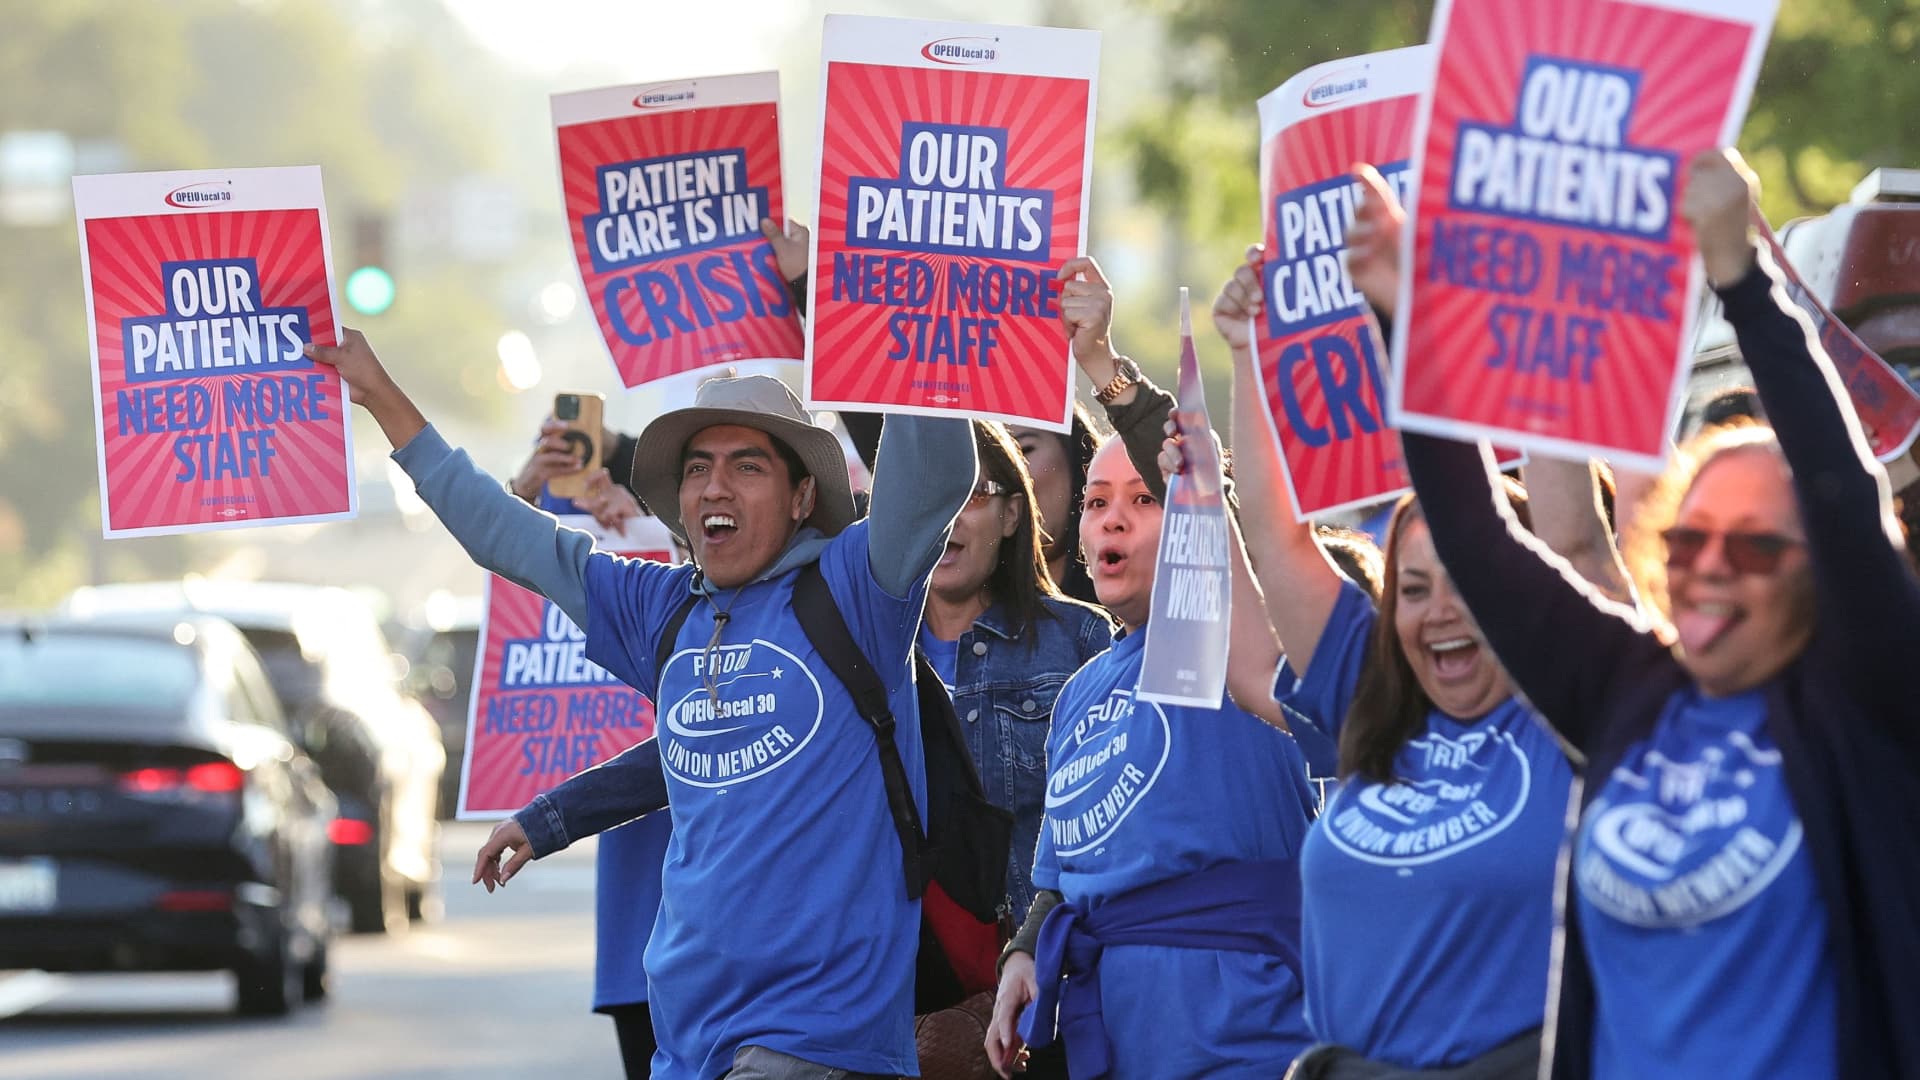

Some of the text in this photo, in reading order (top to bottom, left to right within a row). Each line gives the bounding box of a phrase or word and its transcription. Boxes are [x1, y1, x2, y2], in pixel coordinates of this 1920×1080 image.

[934, 44, 995, 60] OPEIU Local 30
[1520, 64, 1631, 147] OUR
[604, 154, 739, 214] PATIENT
[909, 130, 998, 191] OUR
[1455, 127, 1674, 233] PATIENTS
[176, 191, 231, 202] OPEIU Local 30
[856, 184, 1044, 253] PATIENTS
[595, 192, 760, 263] CARE IS IN
[171, 265, 256, 318] OUR
[603, 243, 794, 347] CRISIS
[831, 252, 1060, 321] NEED MORE
[1428, 217, 1681, 322] NEED MORE
[130, 313, 306, 375] PATIENTS
[888, 314, 1000, 368] STAFF
[1486, 304, 1608, 384] STAFF
[116, 374, 330, 437] NEED MORE
[172, 429, 277, 484] STAFF
[484, 690, 646, 736] NEED MORE
[681, 699, 716, 725] OPEIU
[757, 693, 776, 714] 30
[519, 734, 602, 776] STAFF
[667, 724, 796, 778] UNION MEMBER
[1054, 755, 1087, 794] OPEIU
[1112, 732, 1128, 756] 30
[1049, 762, 1145, 846] NION MEMBER
[1334, 799, 1499, 855] UNION MEMBER
